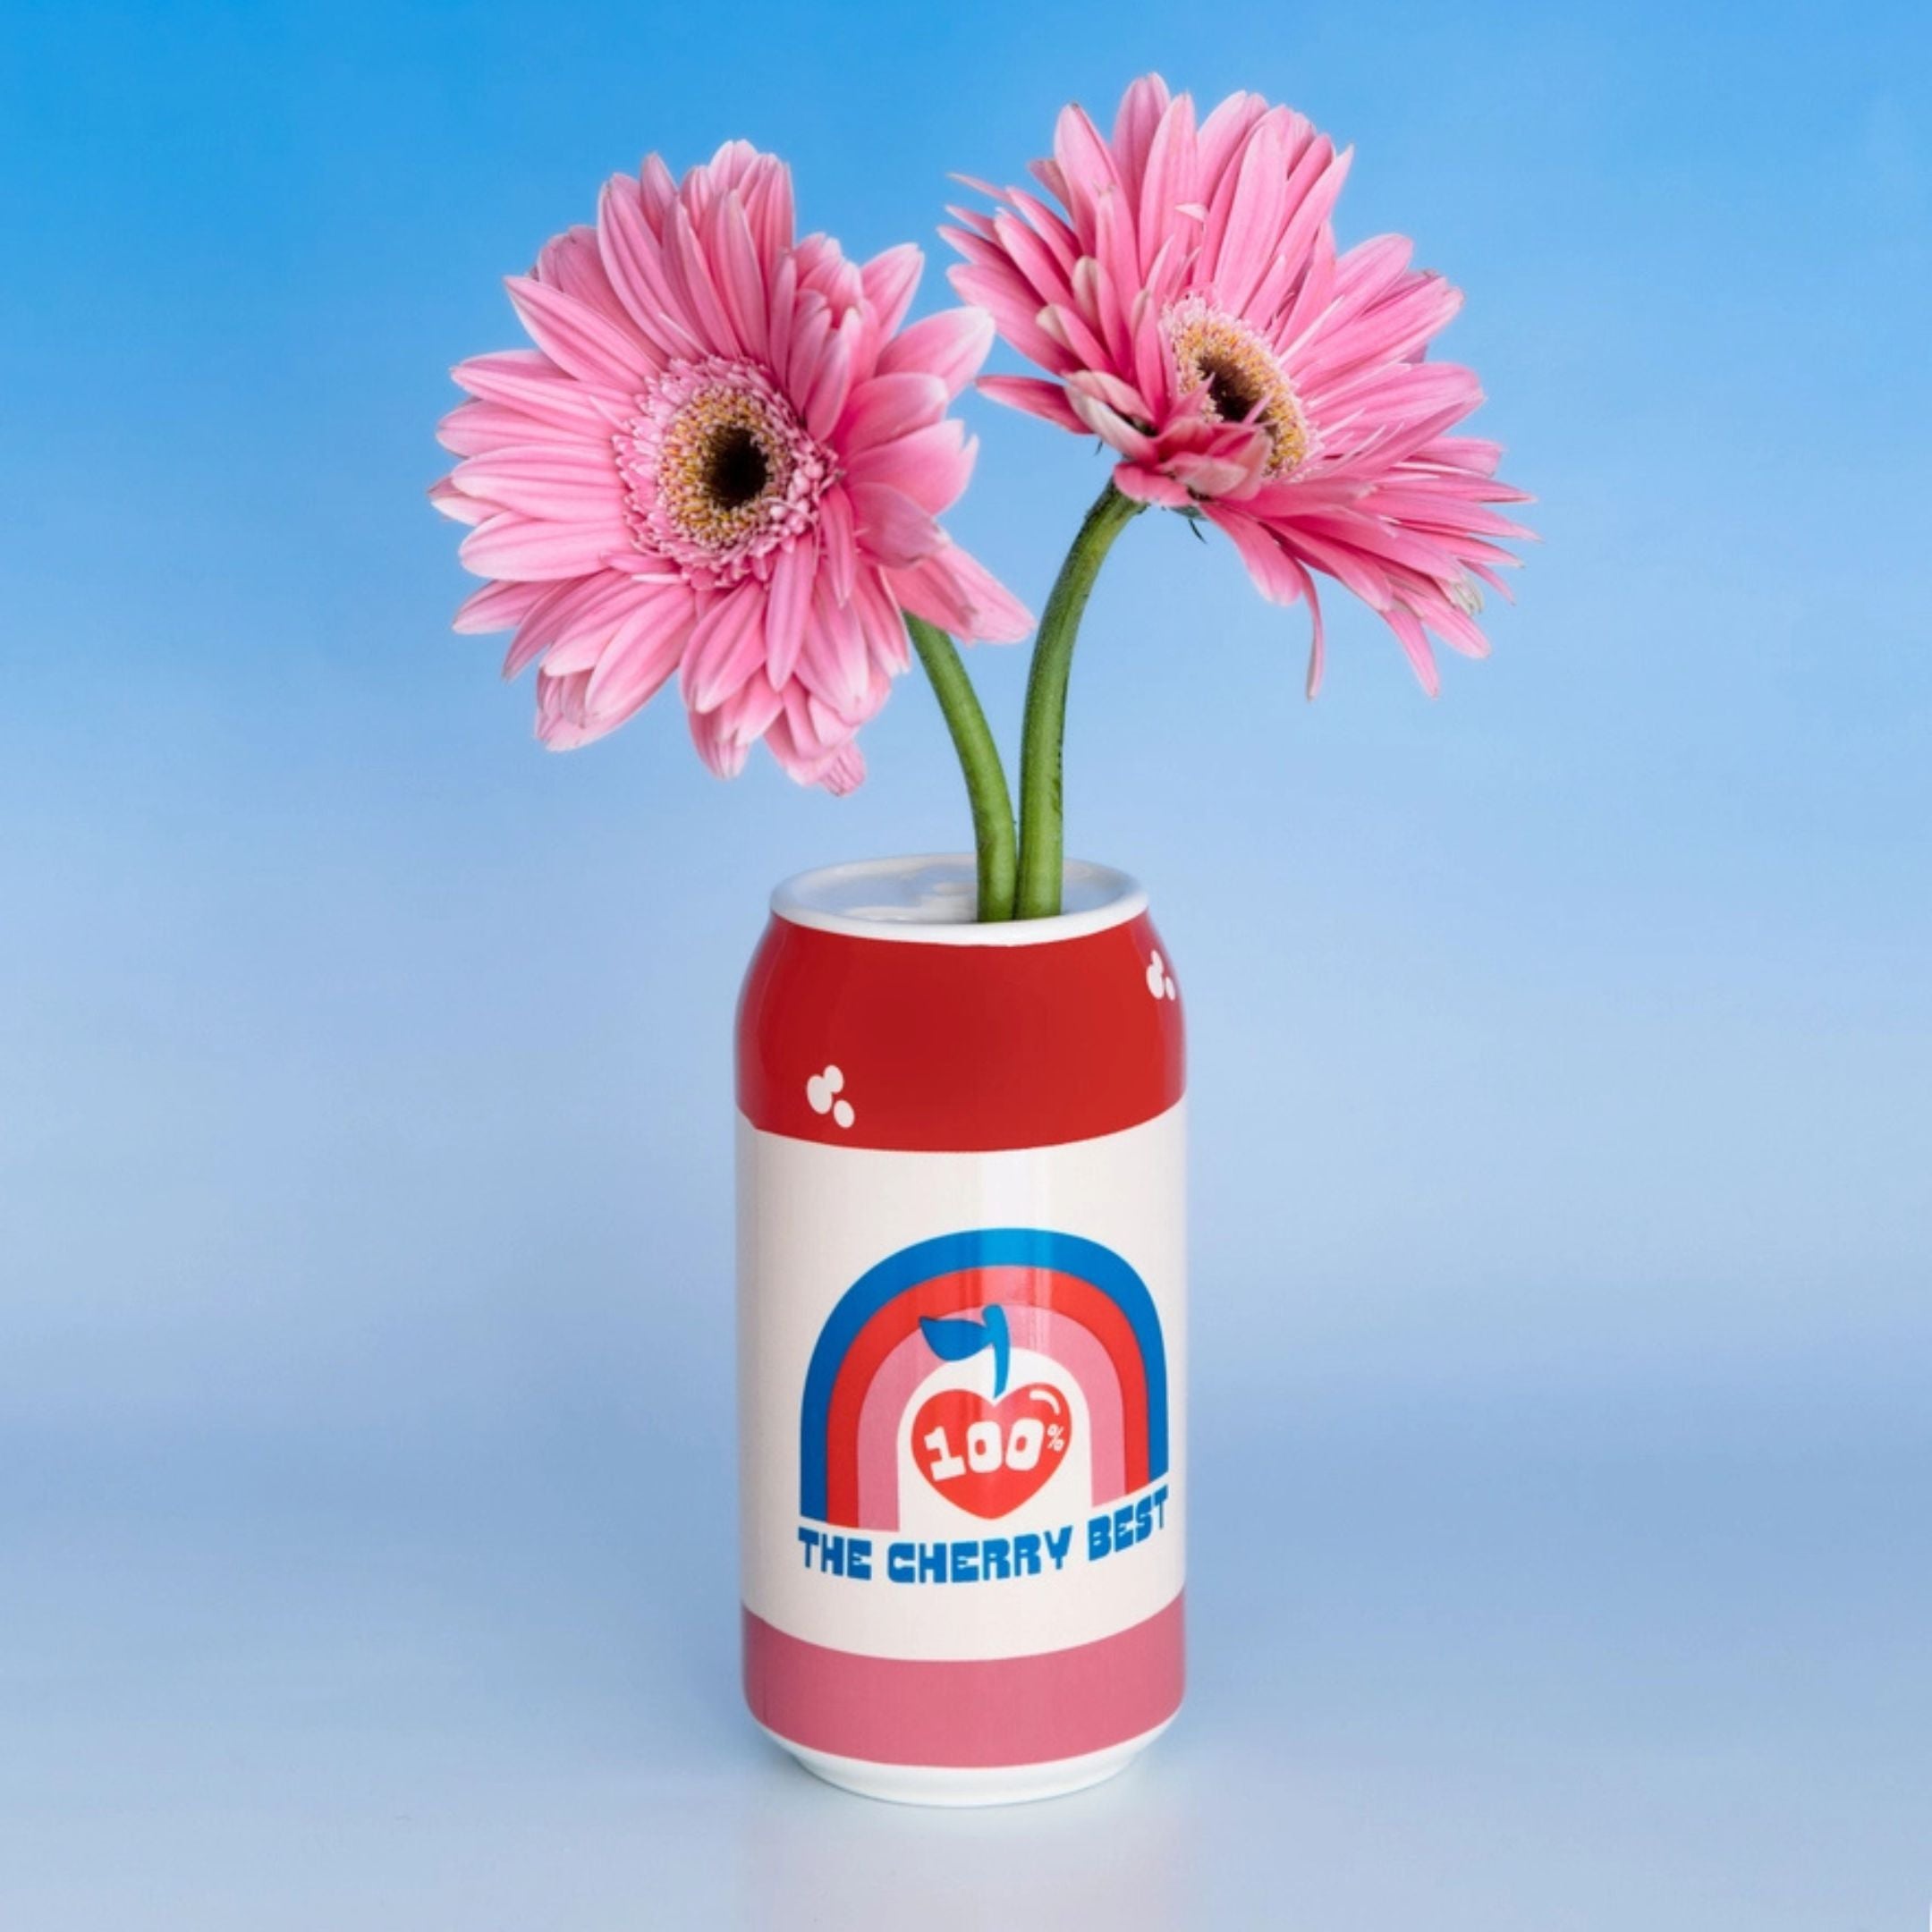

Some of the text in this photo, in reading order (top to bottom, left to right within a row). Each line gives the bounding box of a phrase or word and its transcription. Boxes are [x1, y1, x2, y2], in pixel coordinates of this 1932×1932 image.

[924, 1418, 1064, 1481] 100%
[798, 1484, 1168, 1583] THE CHERRY BEST
